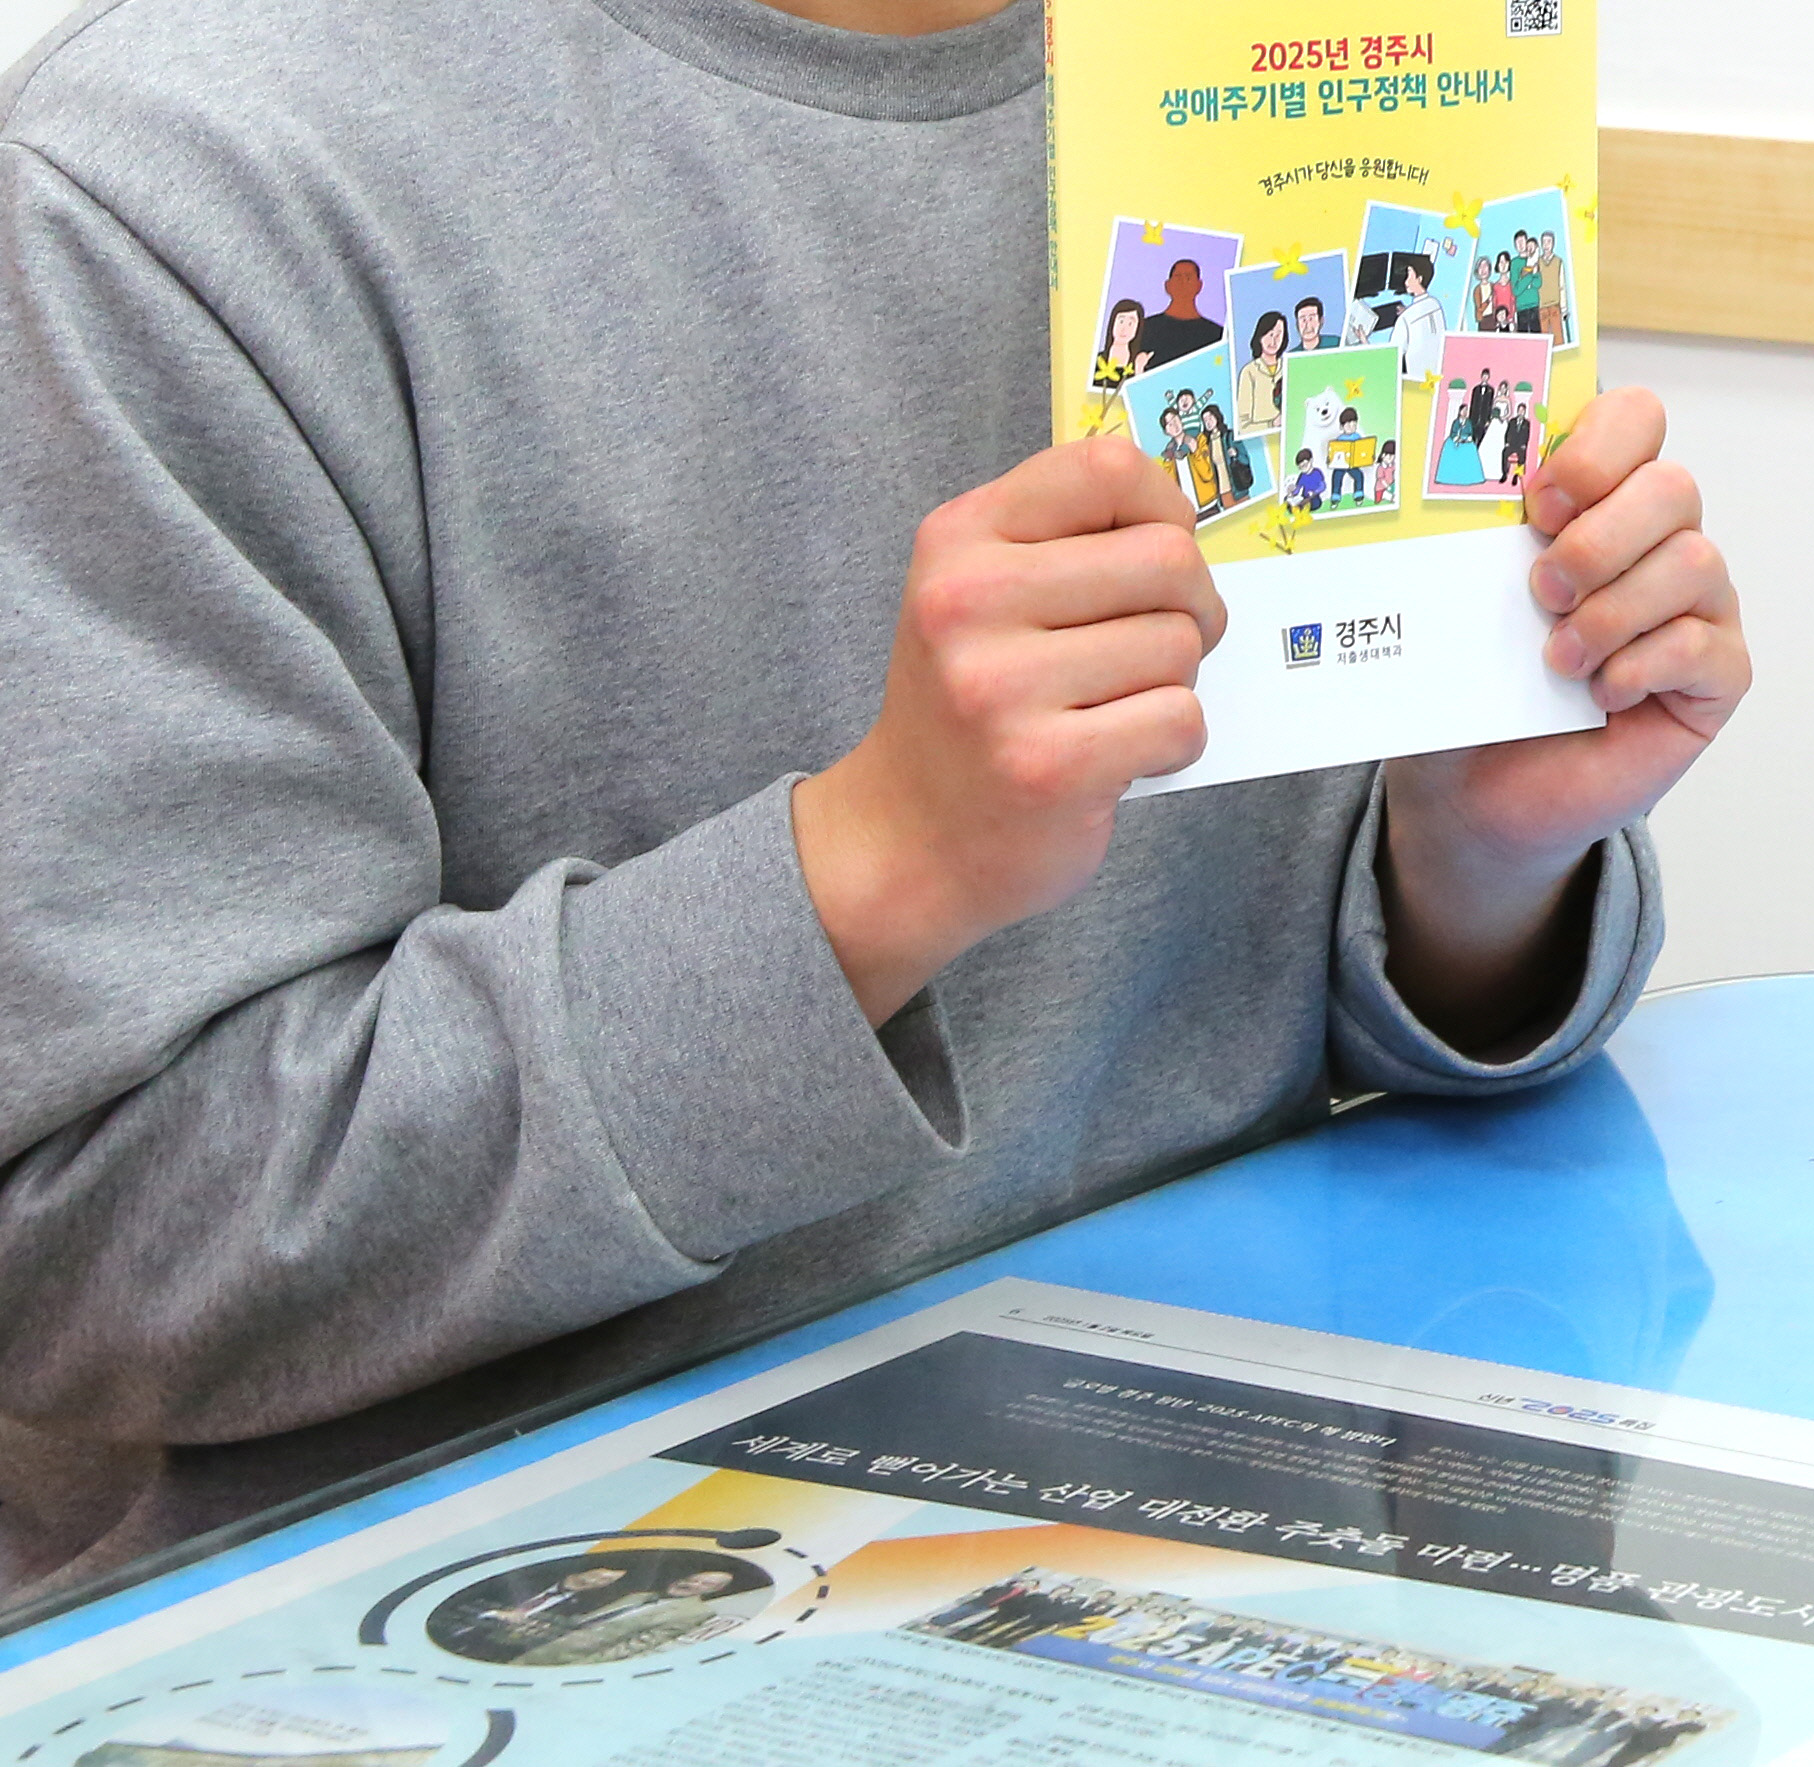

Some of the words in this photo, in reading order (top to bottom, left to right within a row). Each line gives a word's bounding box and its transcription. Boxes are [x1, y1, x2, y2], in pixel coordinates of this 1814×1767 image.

[1251, 37, 1350, 72] 2025년
[1360, 33, 1434, 70] 경주시
[1159, 82, 1307, 127] 생애주기별
[1318, 73, 1427, 116] 인구정책
[1437, 68, 1514, 108] 안내서
[1258, 164, 1314, 196] 경주시가
[1316, 158, 1357, 181] 당신을
[1359, 157, 1430, 186] 응원합니다!
[1336, 613, 1402, 648] 경주시
[1337, 644, 1403, 665] 저출생대책과
[1520, 1396, 1620, 1424] 2025
[731, 1432, 861, 1468] 세계로
[869, 1453, 1029, 1497] 뻗어가는
[1038, 1481, 1133, 1512] 산업
[1138, 1499, 1269, 1534] 대전환
[1274, 1518, 1410, 1558] 주춧돌
